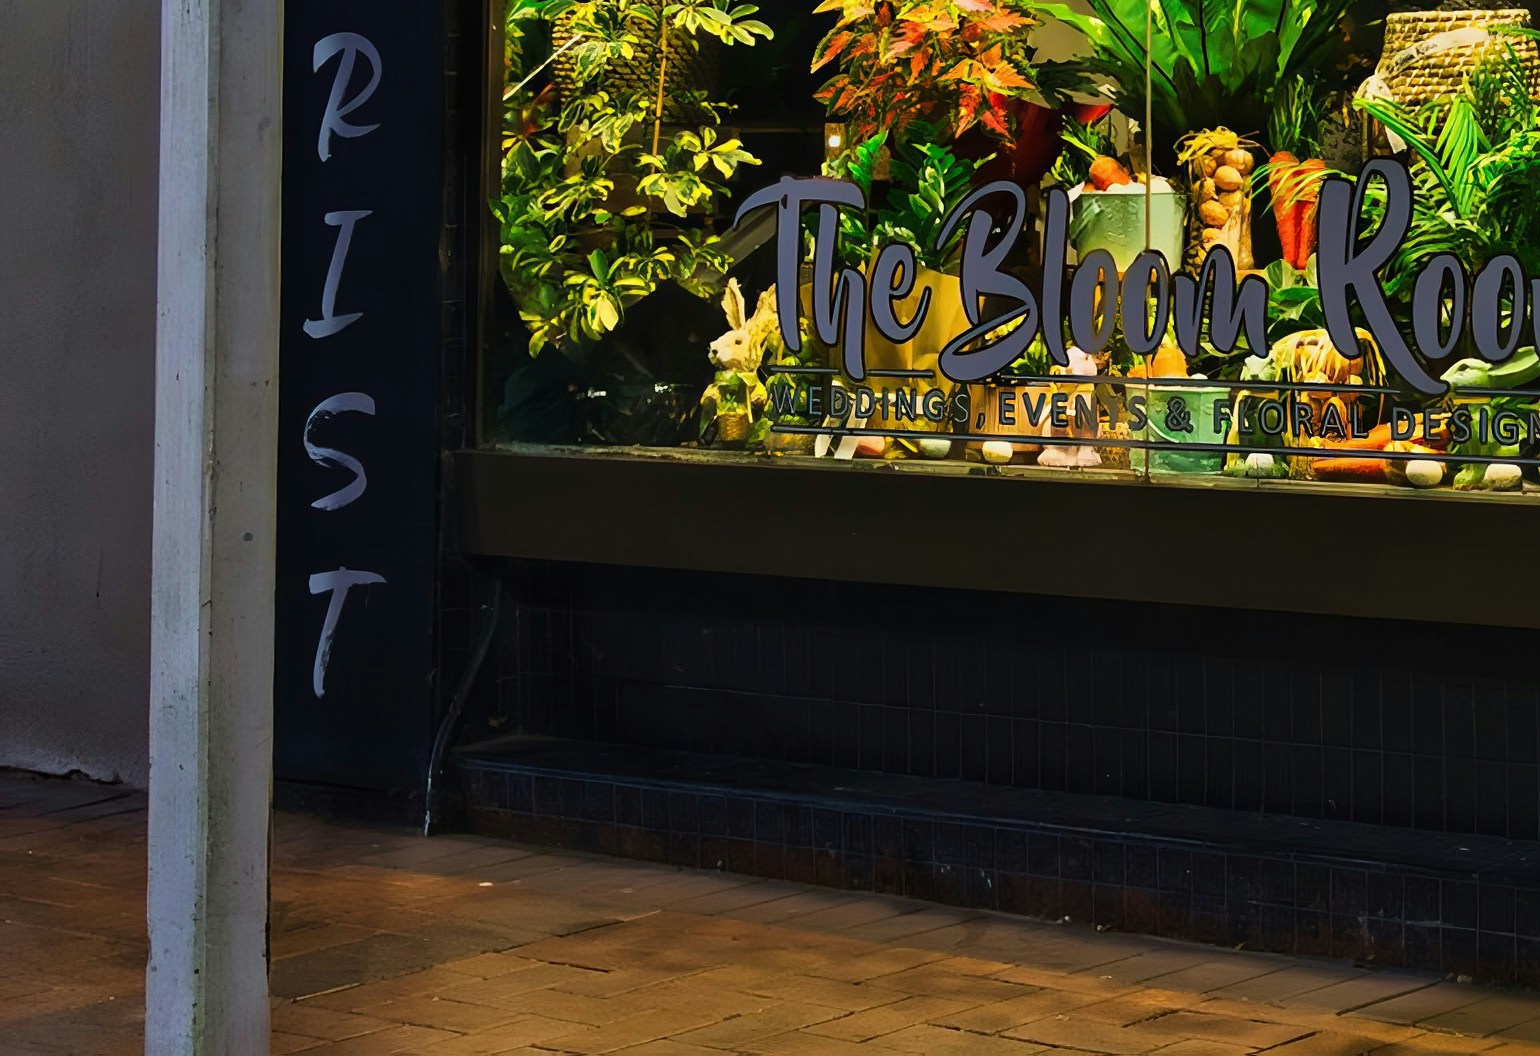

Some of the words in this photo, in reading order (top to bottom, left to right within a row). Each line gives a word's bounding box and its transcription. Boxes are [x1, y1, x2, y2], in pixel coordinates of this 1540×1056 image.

[732, 175, 932, 382] The
[935, 179, 1270, 383] Bloom
[772, 383, 986, 429] WEDDINGS,
[1000, 392, 1148, 432] EVENTS
[1164, 395, 1194, 434] &
[1213, 398, 1370, 440] FLORAL
